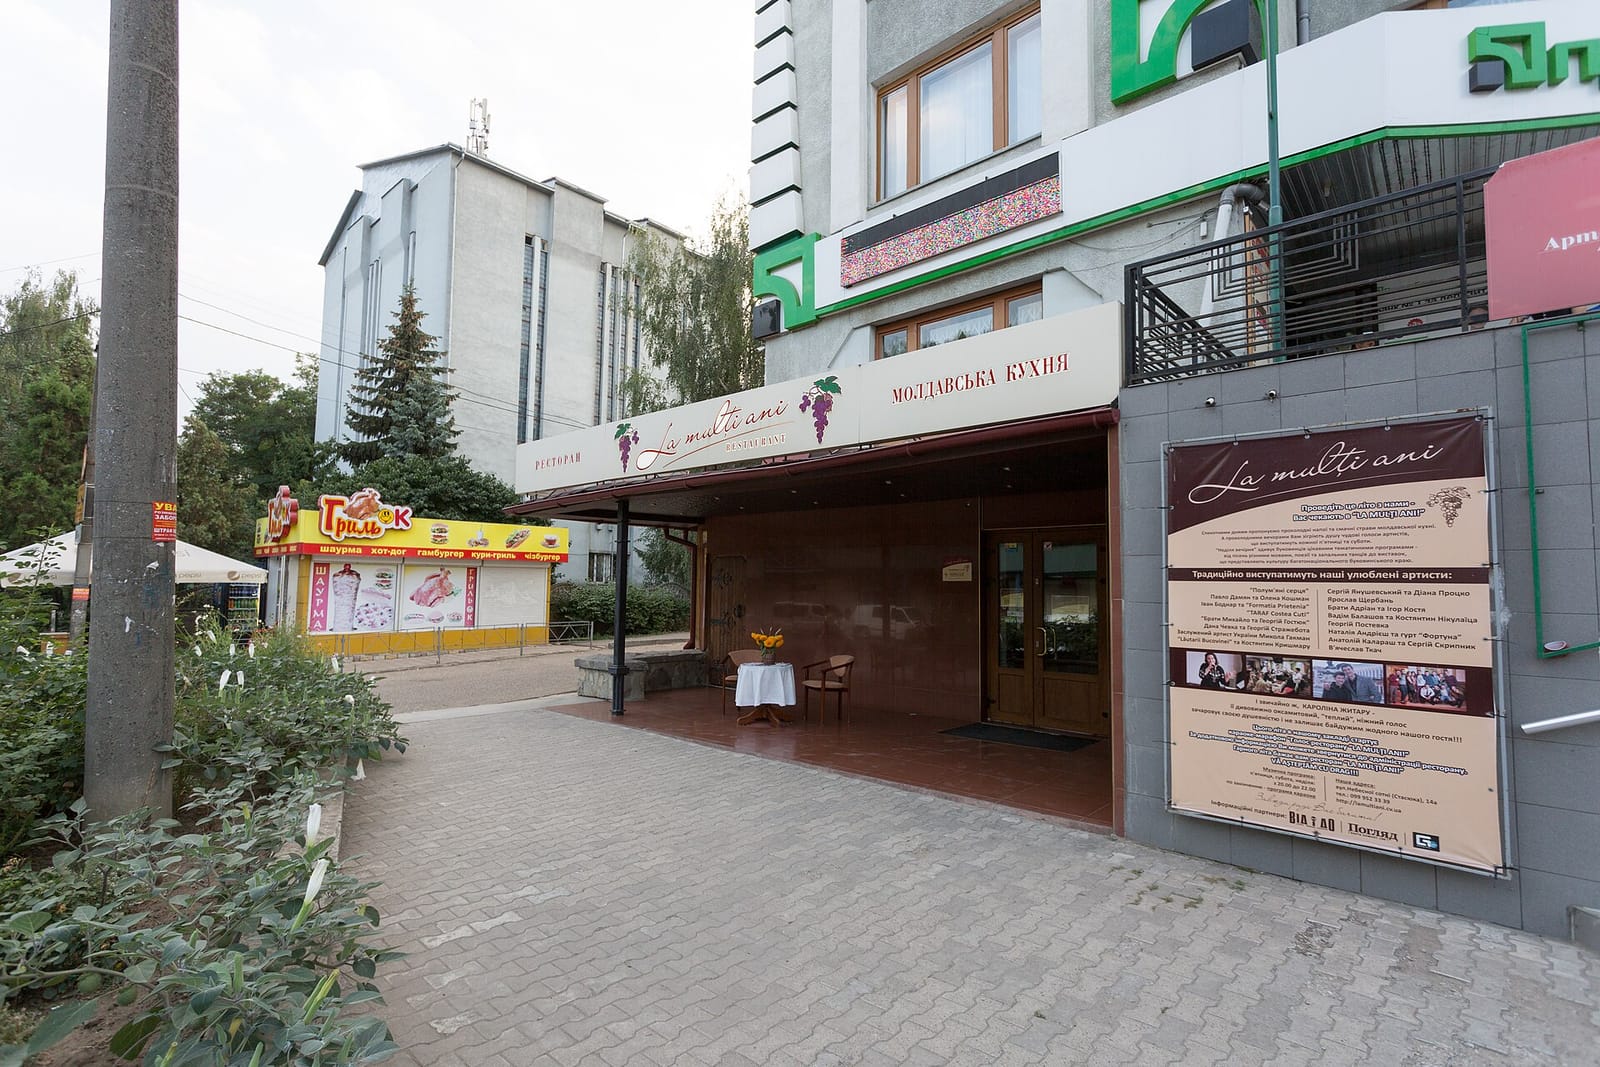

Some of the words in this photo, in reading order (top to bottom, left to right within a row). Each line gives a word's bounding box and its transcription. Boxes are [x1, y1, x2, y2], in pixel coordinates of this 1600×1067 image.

[892, 368, 996, 404] МОЛДАВСЬКА
[1006, 353, 1070, 383] КУХНЯ
[635, 422, 681, 471] La
[742, 399, 790, 425] ani
[726, 433, 786, 453] RESTAURANT
[535, 451, 581, 471] РЕСТОРАН
[1188, 459, 1264, 504] La
[1372, 445, 1444, 467] ani
[1301, 502, 1344, 512] Проведіть
[1357, 501, 1375, 509] літо
[324, 499, 382, 537] Гриль
[320, 546, 362, 554] шаурма
[371, 548, 407, 556] хот-дог
[417, 549, 464, 558] гамбургер
[471, 552, 516, 560] кури-гриль
[524, 554, 560, 562] чізбургер
[1192, 570, 1243, 578] Традиційно
[1347, 570, 1398, 579] улюблені
[312, 566, 327, 628] ШАУРМА
[1347, 822, 1398, 841] Погляд
